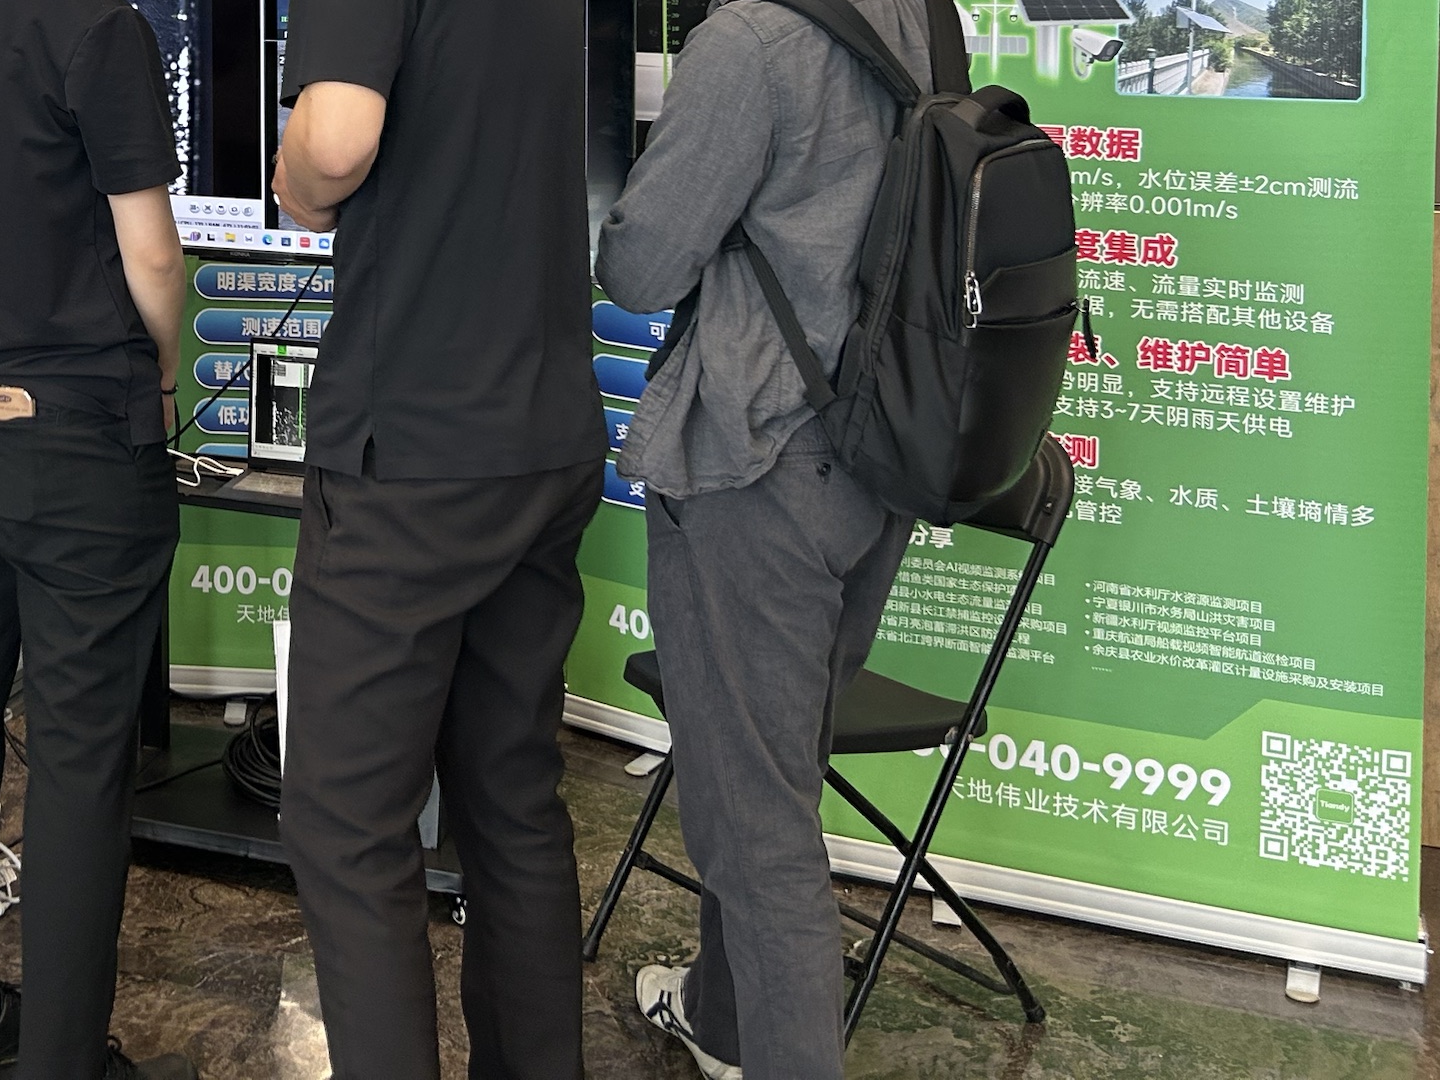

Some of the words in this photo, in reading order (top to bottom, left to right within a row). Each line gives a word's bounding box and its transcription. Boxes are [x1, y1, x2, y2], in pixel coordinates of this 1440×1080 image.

[1077, 268, 1305, 305] 流速、流量实时监测
[1048, 431, 1100, 470] 测
[1066, 498, 1123, 525] 管控
[191, 565, 293, 597] 400-0
[1092, 580, 1263, 614] 河南省水利厅水资源监测项目
[610, 604, 651, 640] 40
[1092, 596, 1275, 633] 宁夏银川市水务局山洪灾害项目
[1092, 612, 1262, 647] 新疆水利厅视频监控平台项目
[1092, 627, 1315, 671] 重庆航道局船载视频智能航道巡检项目
[912, 734, 1232, 807] -040-9999
[1320, 799, 1350, 813] Tiandy
